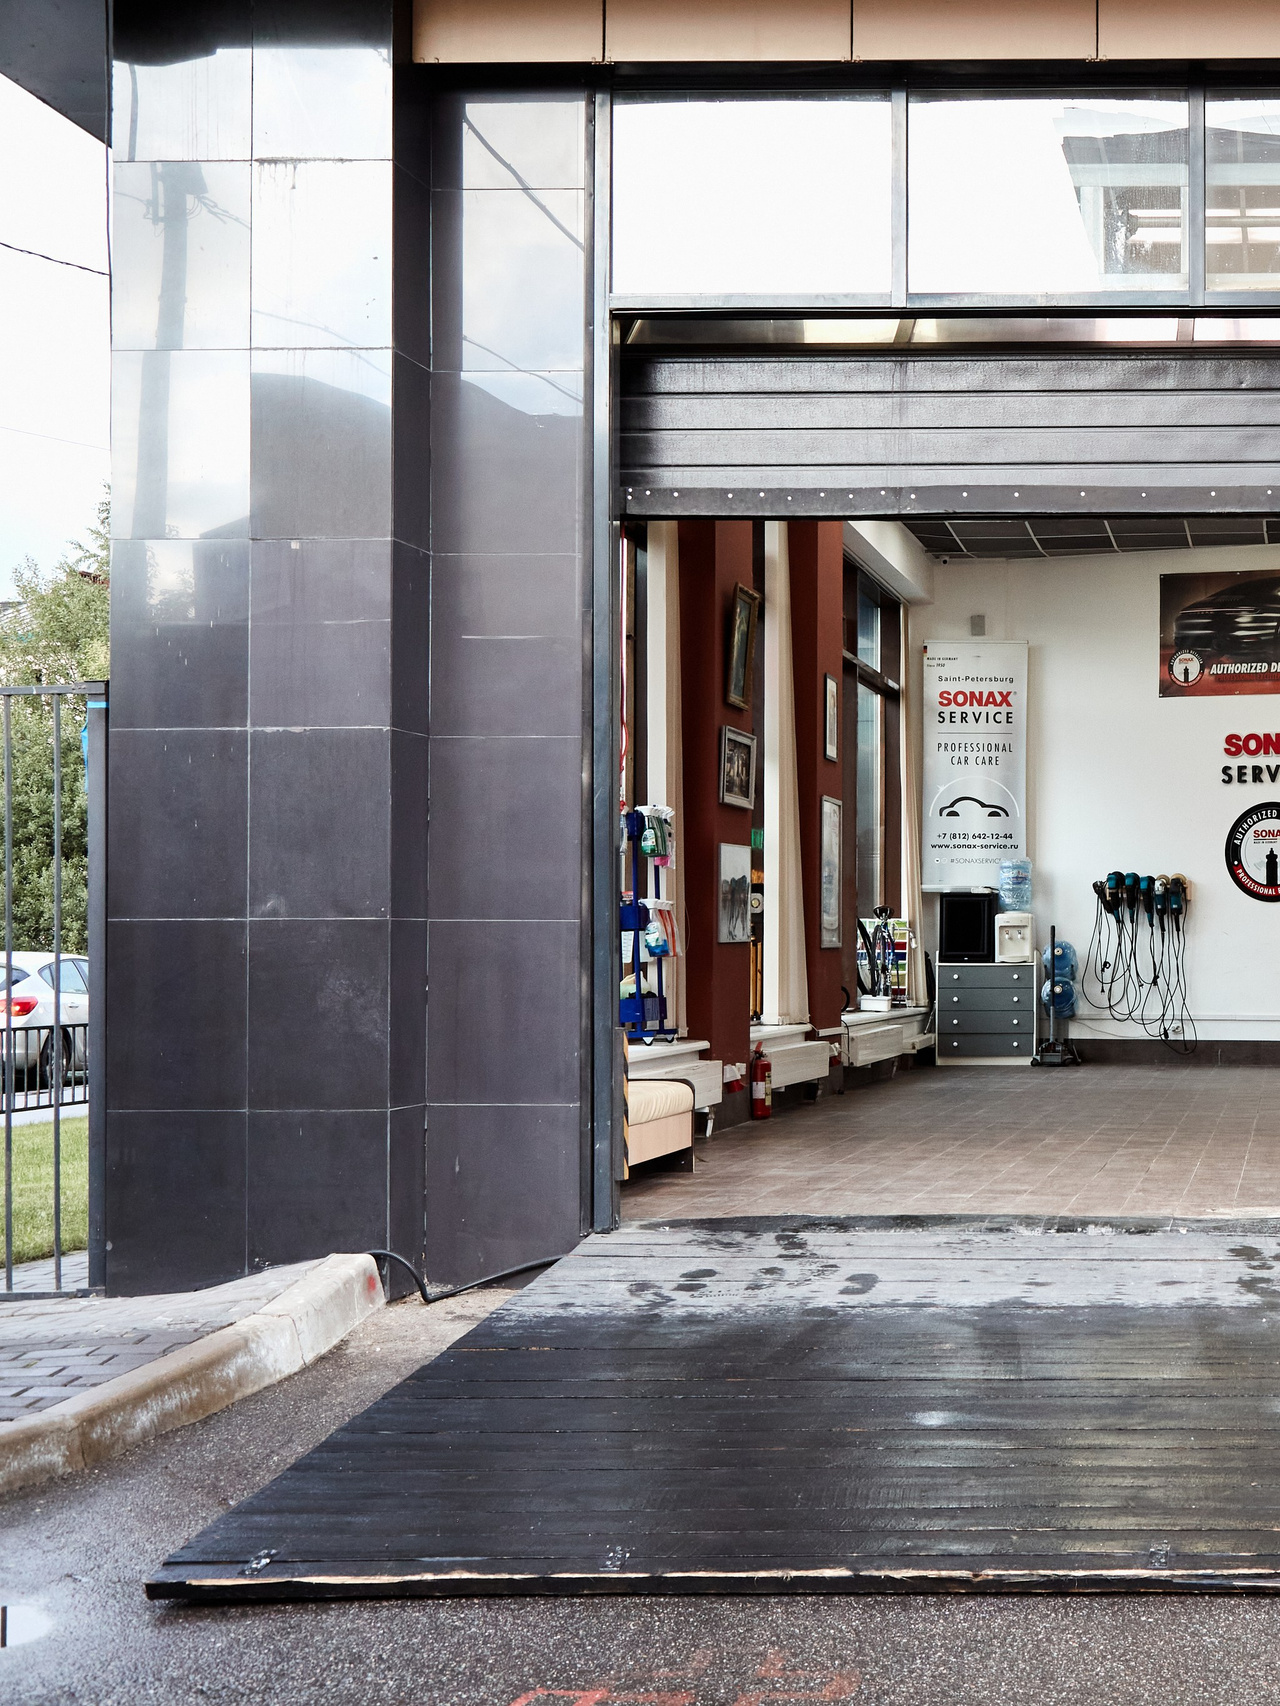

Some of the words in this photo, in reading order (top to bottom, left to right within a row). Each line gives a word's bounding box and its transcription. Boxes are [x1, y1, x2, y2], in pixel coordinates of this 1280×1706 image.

[1210, 662, 1269, 675] AUTHORIZED
[937, 675, 1014, 684] Saint-Petersburg
[938, 690, 1013, 707] SONAX
[937, 711, 1013, 724] SERVICE
[937, 742, 1013, 753] PROFESSIONAL
[950, 755, 969, 766] CAR
[974, 755, 1000, 766] CARE
[1233, 809, 1278, 846] AUTHORIZED
[937, 832, 947, 840] +7
[949, 832, 970, 841] (812)
[971, 832, 1013, 840] 642-12-44
[930, 842, 1019, 850] www.sonax-service.ru
[1236, 868, 1276, 895] PROFESSIONAL
